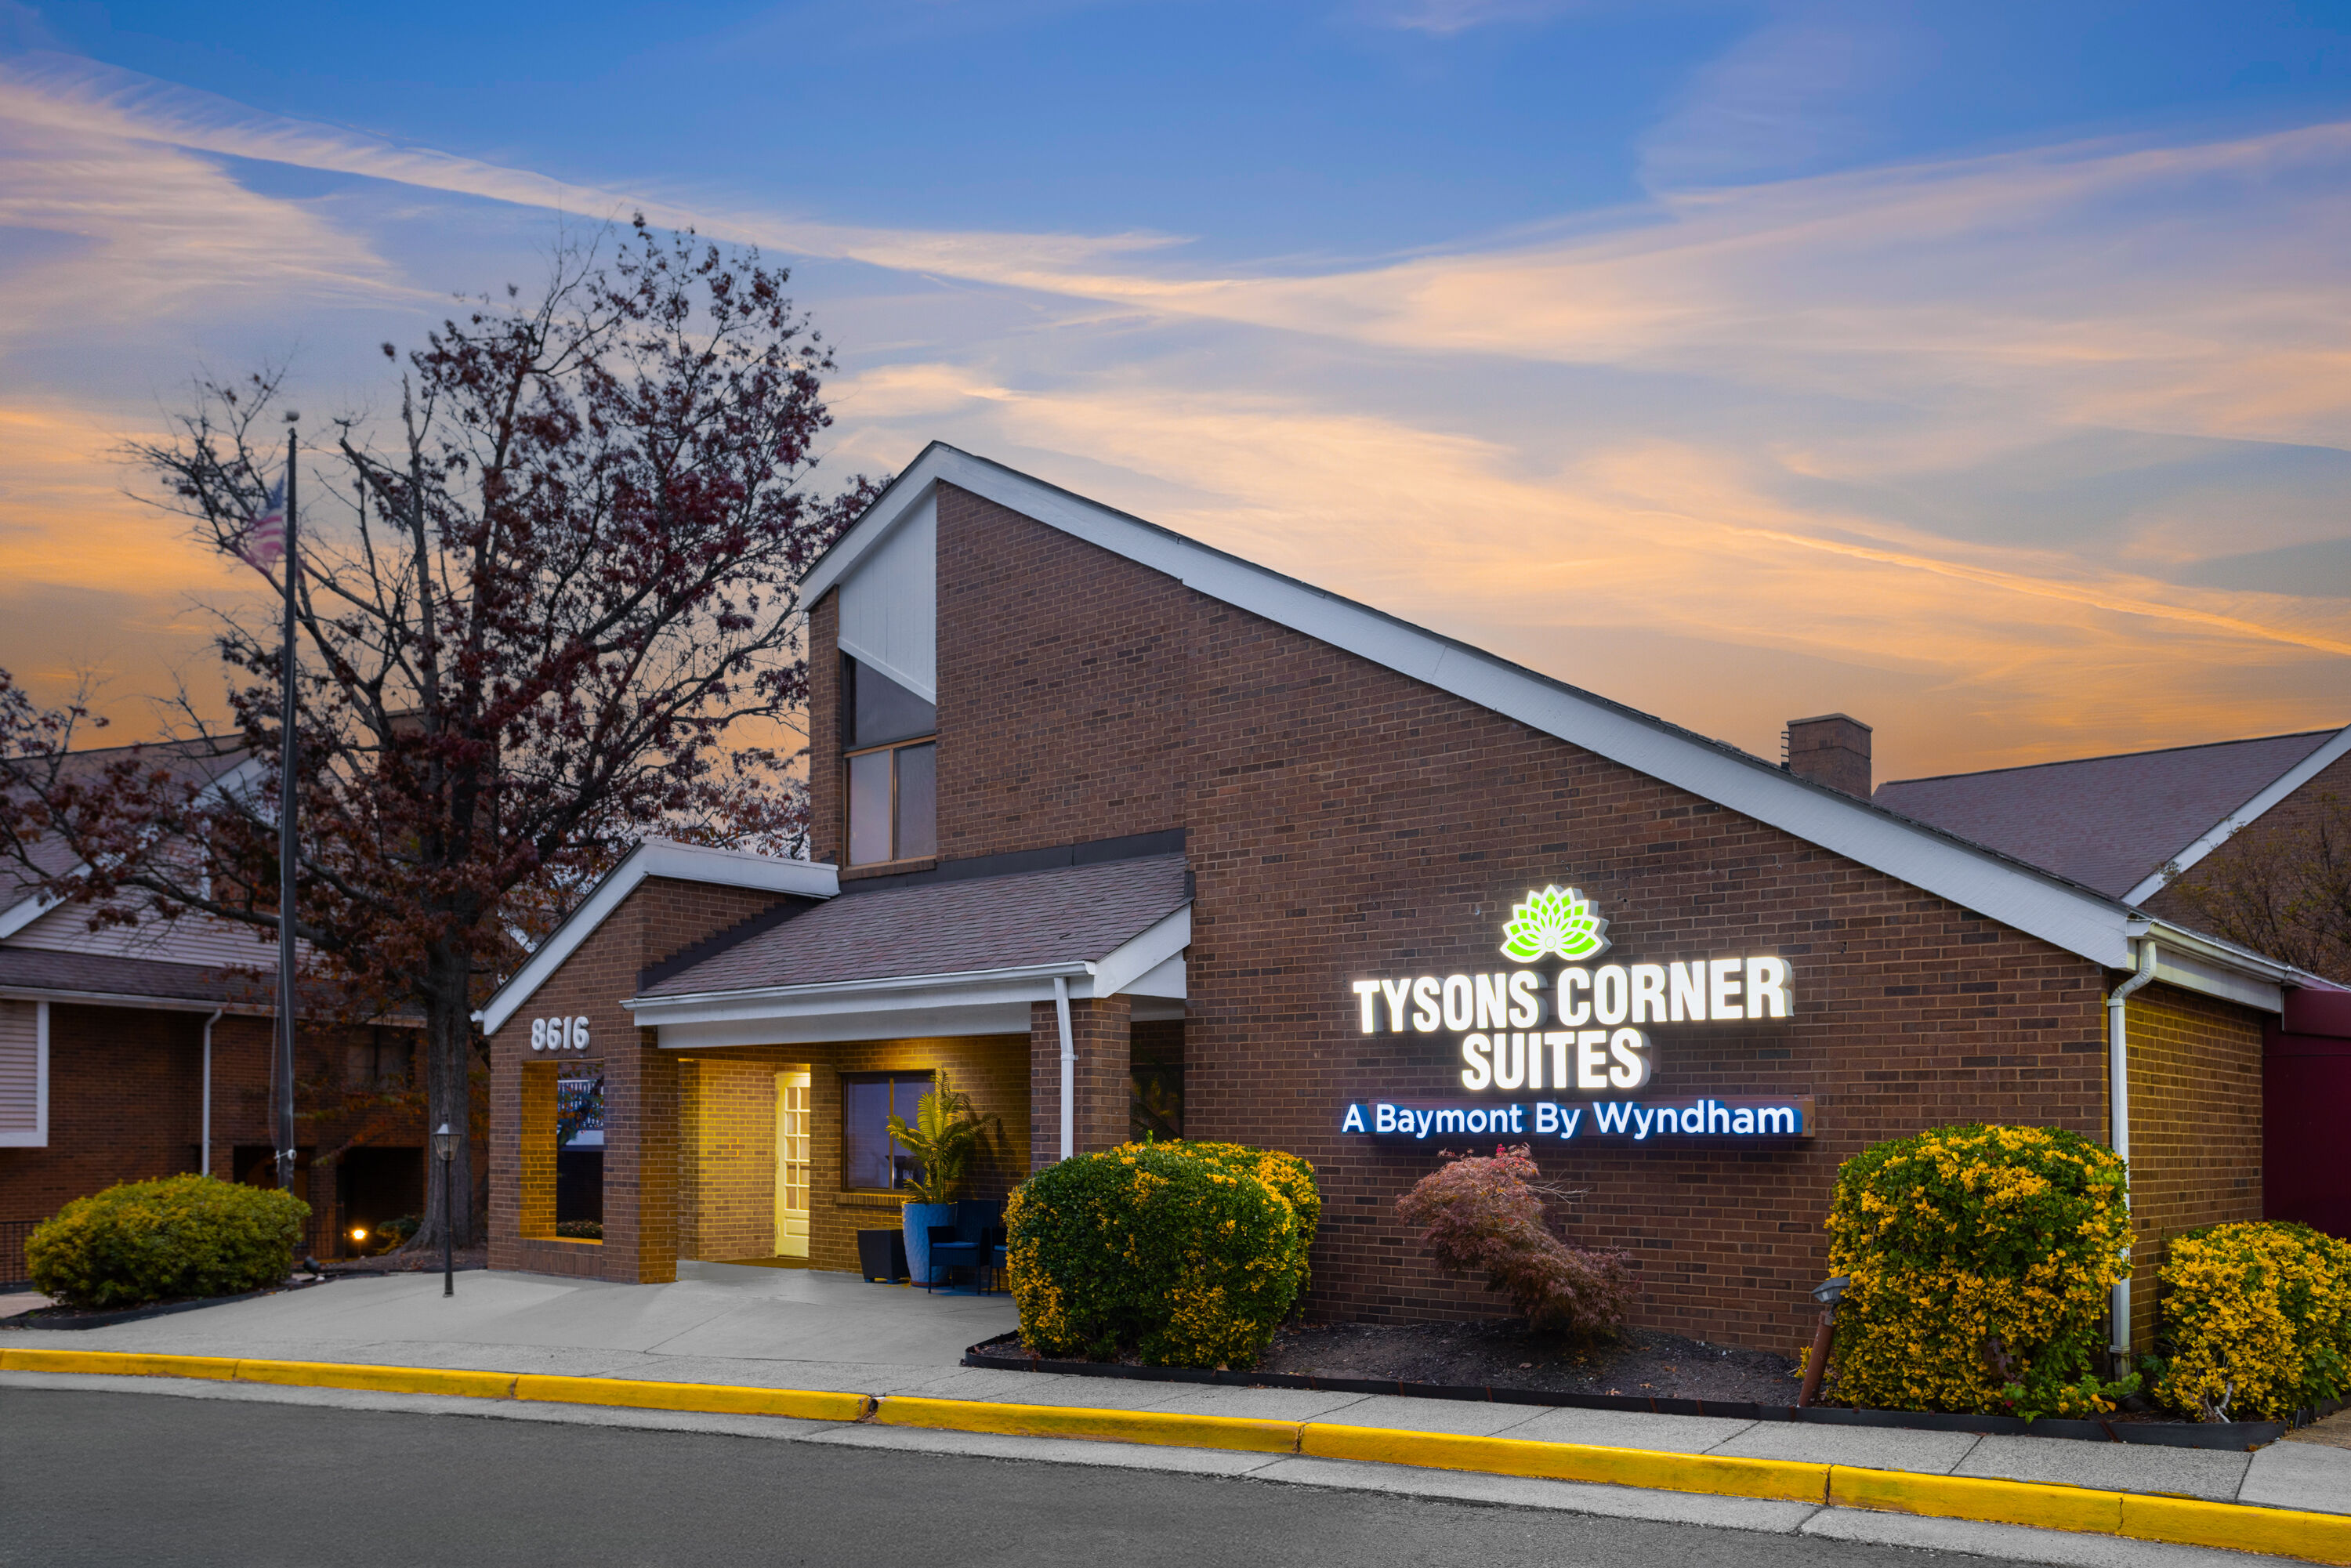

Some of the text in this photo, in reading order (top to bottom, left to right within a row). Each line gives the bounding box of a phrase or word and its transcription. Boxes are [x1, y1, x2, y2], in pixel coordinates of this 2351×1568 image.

[1353, 956, 1795, 1034] TYSONS CORNER
[531, 1016, 589, 1052] 8616
[1462, 1027, 1646, 1091] SUITES
[1342, 1099, 1796, 1141] A Baymont By Wyndham
